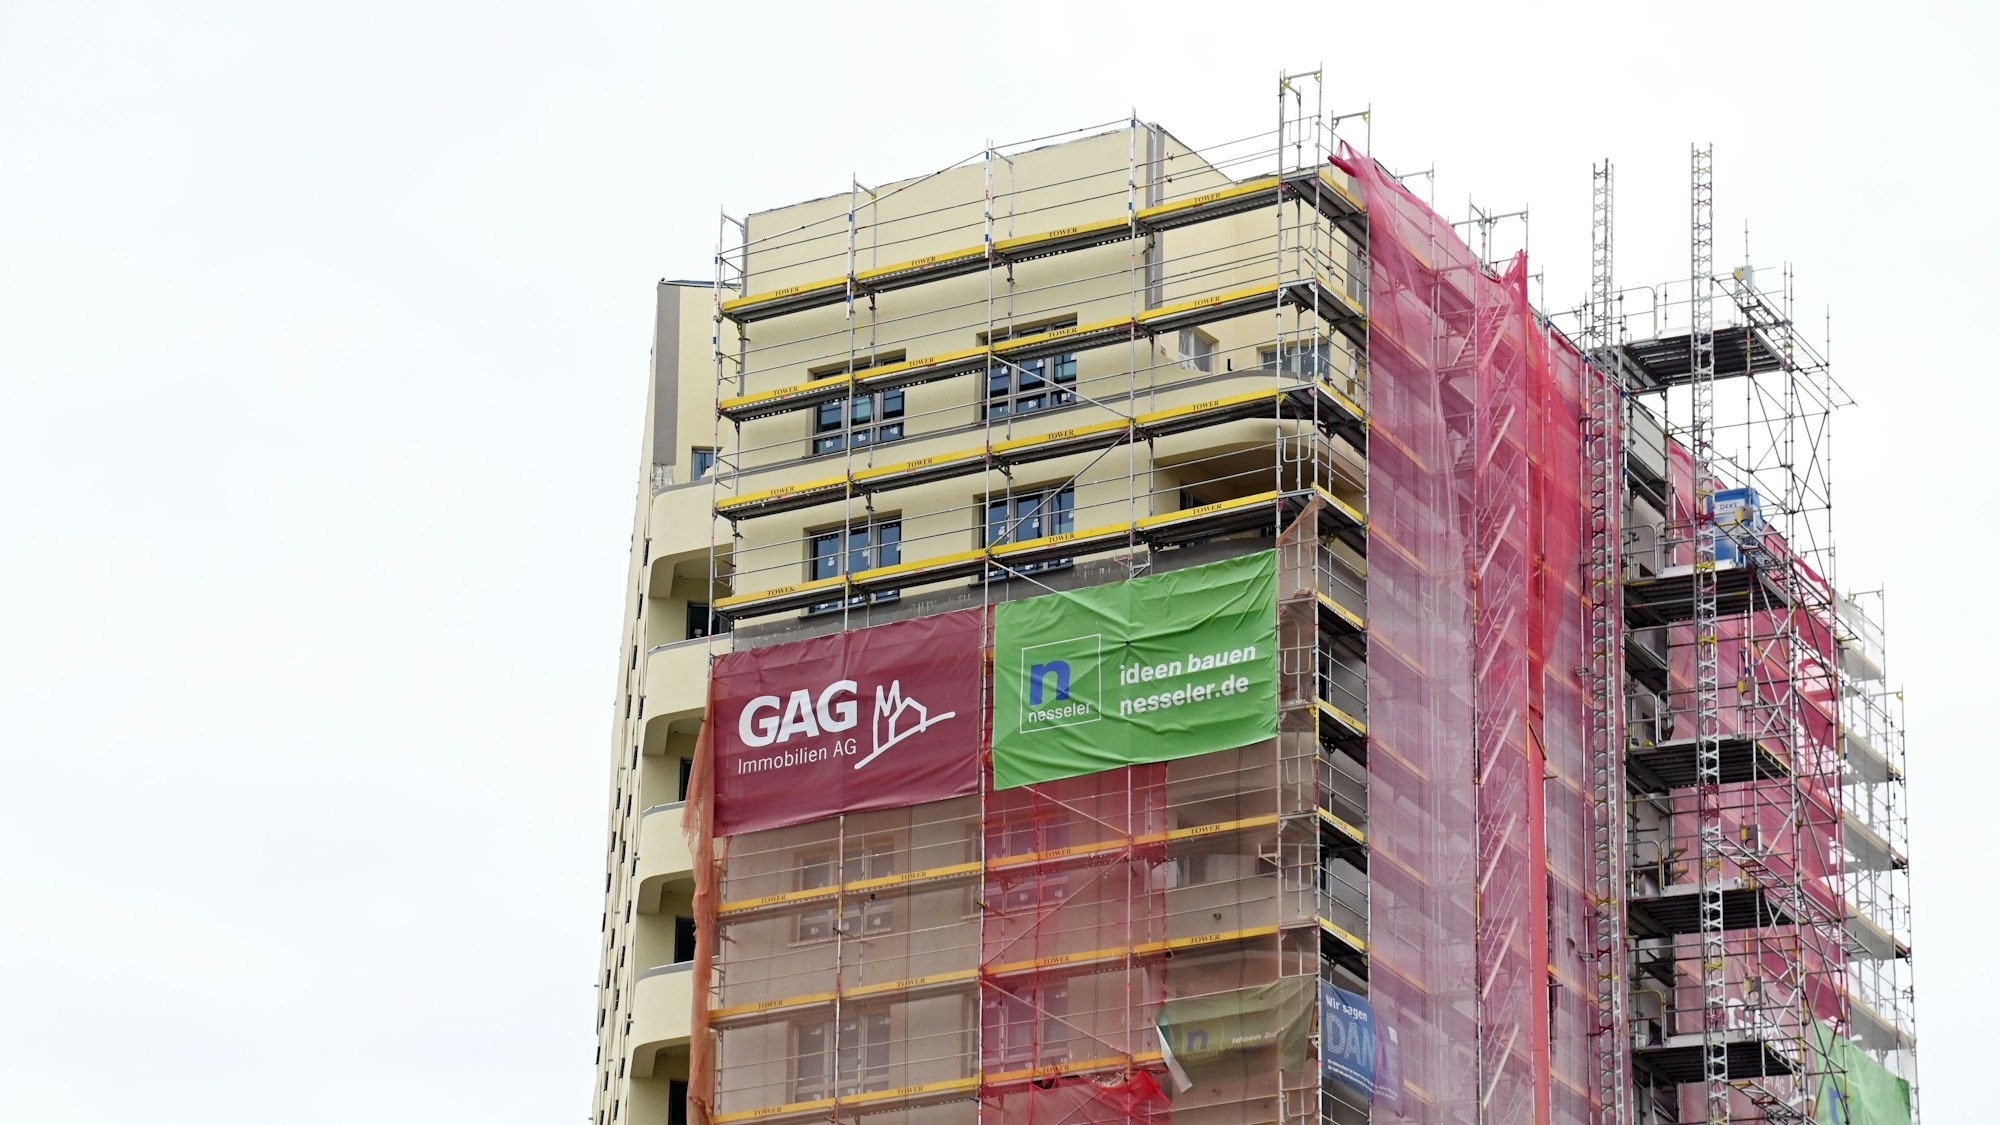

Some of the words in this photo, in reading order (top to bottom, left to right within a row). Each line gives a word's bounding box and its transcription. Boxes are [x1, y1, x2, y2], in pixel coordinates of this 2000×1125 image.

[1194, 193, 1221, 204] TOWER
[1049, 226, 1078, 237] TOWER
[911, 256, 937, 267] TOWER
[775, 286, 800, 298] TOWER
[1193, 296, 1221, 307] TOWER
[1048, 327, 1077, 338] TOWER
[909, 357, 935, 368] TOWER
[774, 386, 798, 396] TOWER
[1192, 400, 1219, 411] TOWER
[1048, 429, 1074, 440] TOWER
[907, 458, 933, 469] TOWER
[770, 485, 795, 496] TOWER
[1192, 503, 1222, 515] TOWER
[1048, 532, 1075, 543] TOWER
[1120, 662, 1182, 686] ideen
[1188, 645, 1256, 674] bauen
[1029, 660, 1071, 706] n
[1120, 674, 1250, 716] nesseler.de
[738, 680, 858, 747] GAG
[1028, 700, 1092, 724] nesseler
[738, 748, 828, 775] Immobilien
[833, 738, 858, 756] AG
[1191, 824, 1221, 835] TOWER
[1044, 848, 1072, 859] TOWER
[901, 871, 927, 881] TOWER
[761, 894, 786, 905] TOWER
[1191, 934, 1221, 945] TOWER
[1043, 954, 1070, 965] TOWER
[897, 977, 926, 988] TOWER
[758, 1000, 783, 1010] TOWER
[1326, 994, 1340, 1010] Wir
[1343, 1004, 1368, 1021] sagen
[1232, 1033, 1262, 1045] ideen
[1326, 1011, 1377, 1073] DAN
[897, 1085, 924, 1096] TOWER
[754, 1106, 783, 1117] TOWER
